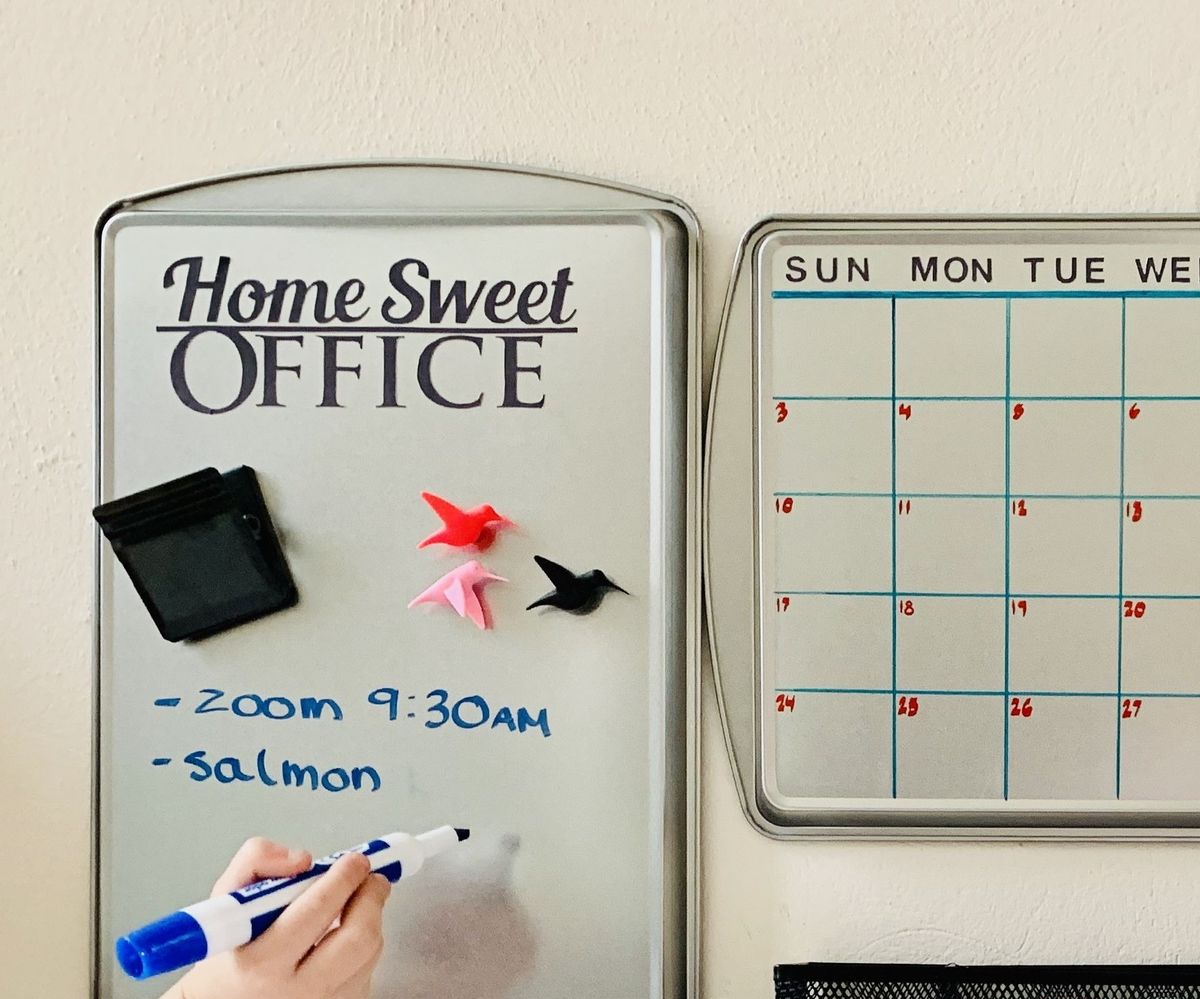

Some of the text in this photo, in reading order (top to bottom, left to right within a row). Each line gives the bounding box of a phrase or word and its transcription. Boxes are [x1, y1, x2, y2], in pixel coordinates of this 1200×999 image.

[785, 255, 870, 283] SUN
[911, 256, 993, 283] MON
[1023, 257, 1105, 284] TUE
[163, 256, 577, 324] Home Sweet
[170, 328, 546, 415] OFFICE
[776, 402, 788, 422] 3
[898, 404, 912, 420] 4
[1128, 404, 1140, 420] 6
[775, 497, 794, 514] 10
[899, 501, 911, 515] 11
[1012, 500, 1028, 517] 12
[1126, 501, 1143, 522] 13
[776, 597, 791, 612] 17
[900, 600, 915, 616] 18
[1012, 601, 1028, 617] 19
[1123, 600, 1146, 619] 20
[367, 687, 551, 737] 9:30AM
[775, 694, 796, 713] 24
[898, 697, 919, 717] 25
[1011, 697, 1034, 718] 26
[1122, 699, 1143, 719] 27
